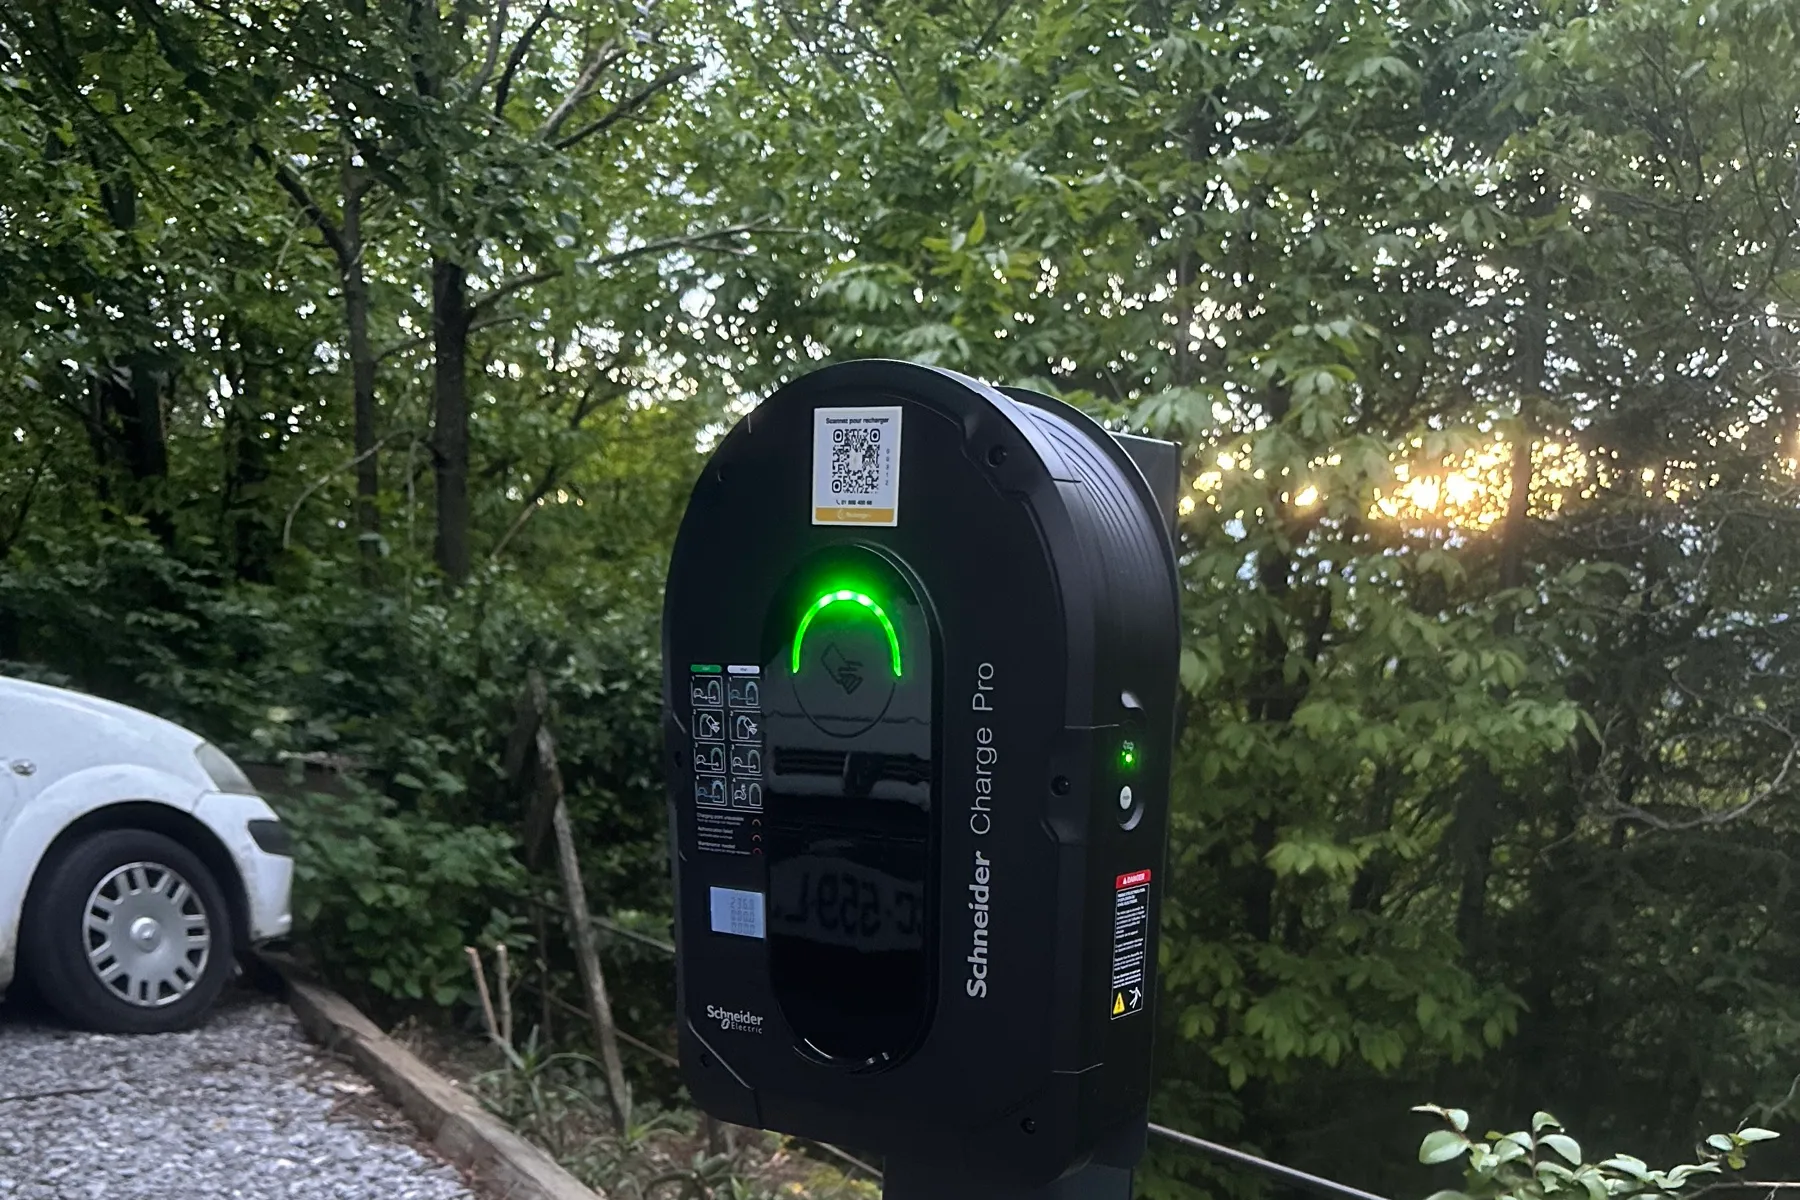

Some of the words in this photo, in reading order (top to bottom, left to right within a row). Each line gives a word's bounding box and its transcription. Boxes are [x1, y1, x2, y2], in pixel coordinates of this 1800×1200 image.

[863, 417, 889, 425] recharger
[972, 662, 994, 711] Pro
[970, 727, 997, 835] Charge
[966, 851, 990, 998] Schneider
[706, 1004, 764, 1026] Schneider
[731, 1021, 763, 1034] Electric
